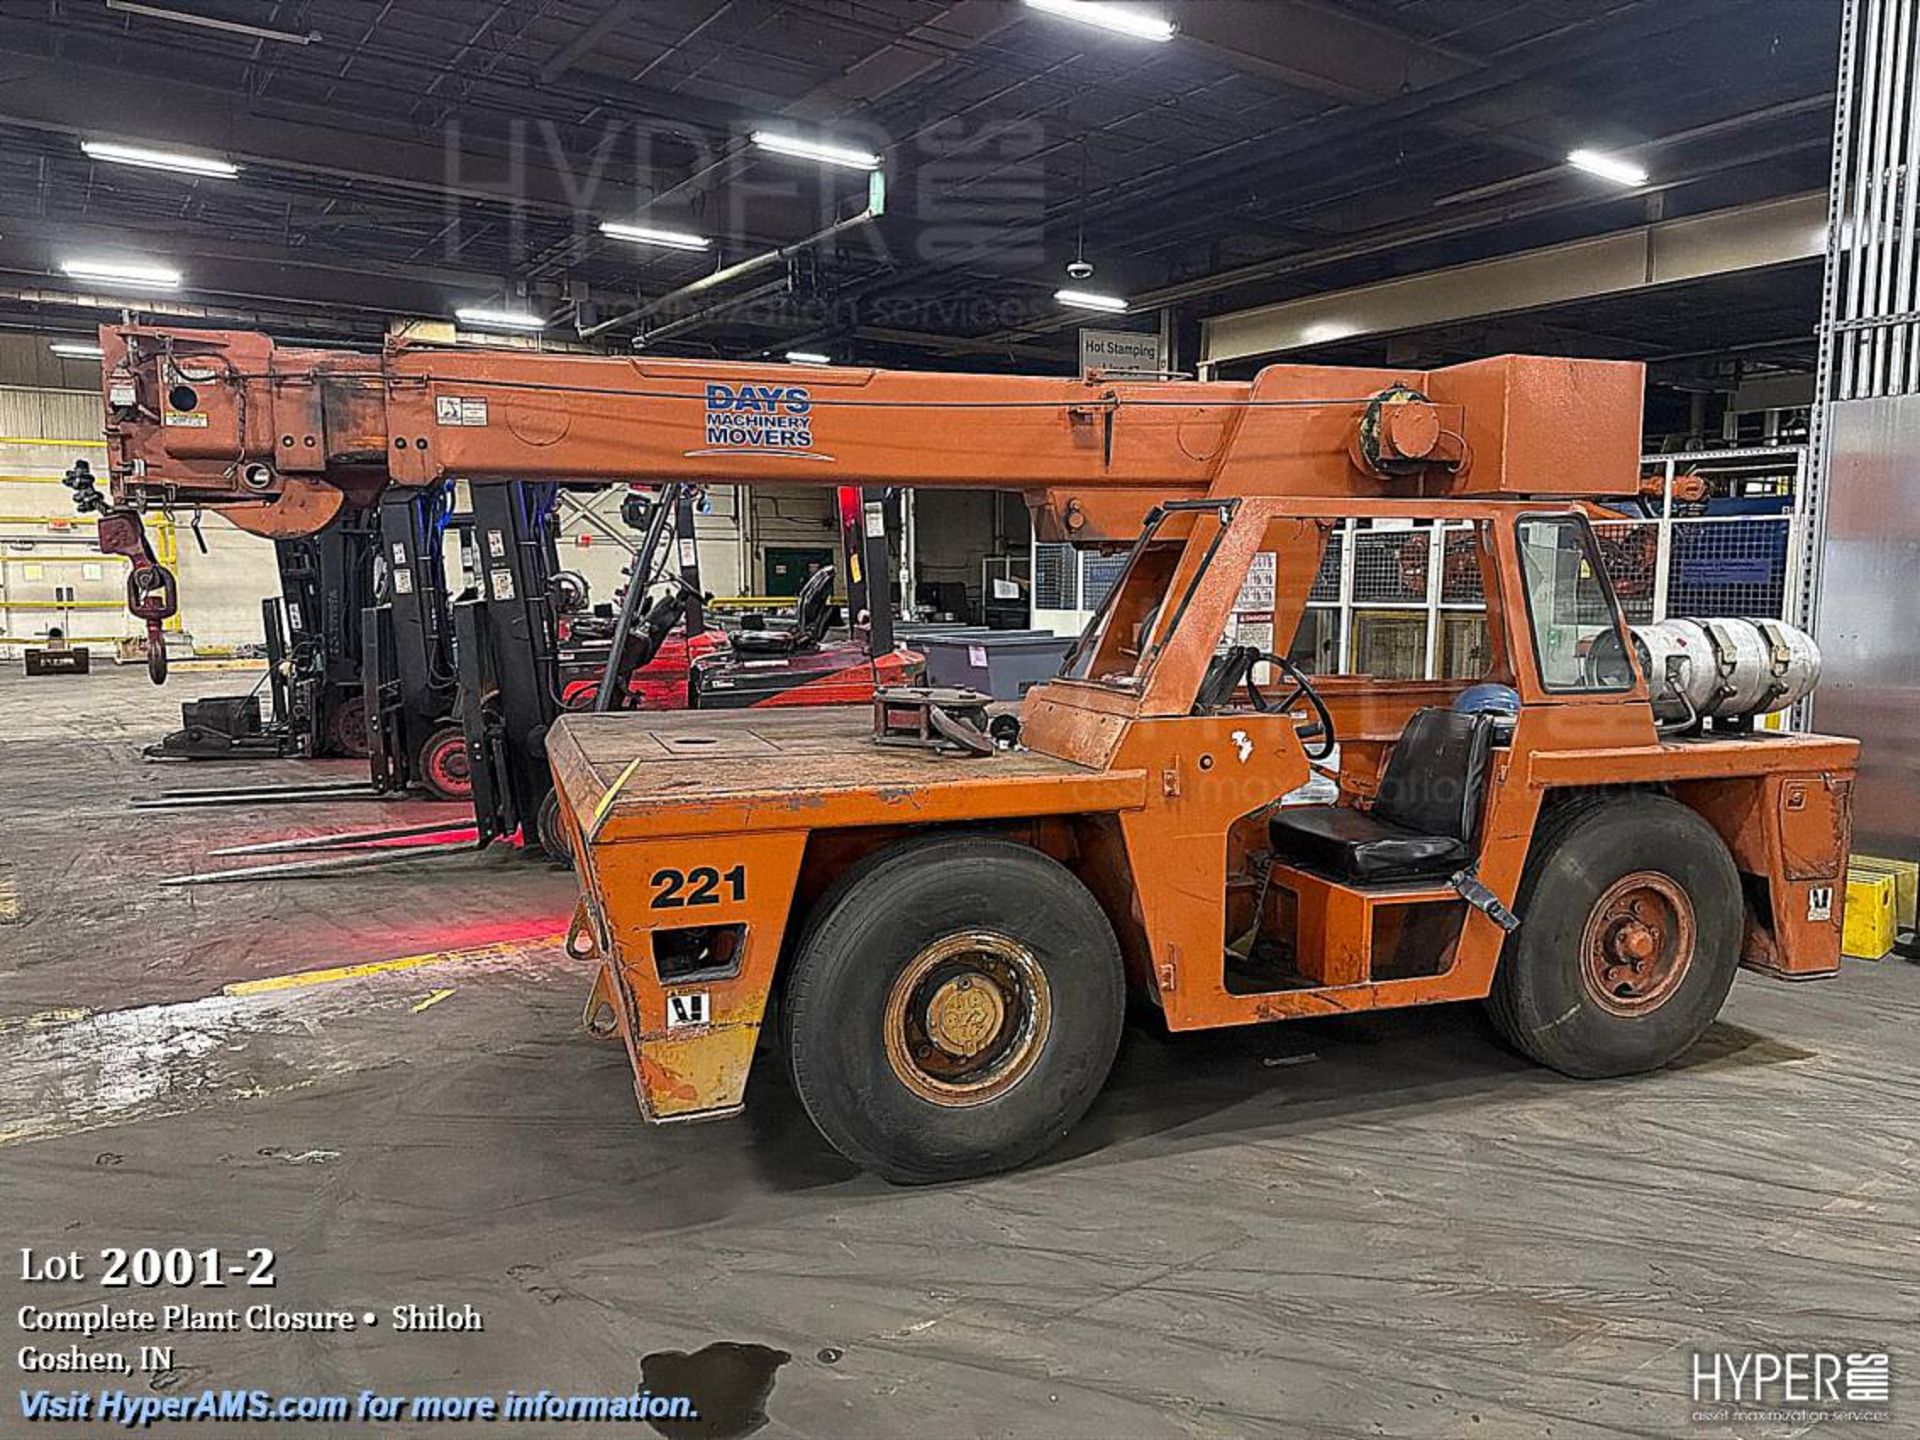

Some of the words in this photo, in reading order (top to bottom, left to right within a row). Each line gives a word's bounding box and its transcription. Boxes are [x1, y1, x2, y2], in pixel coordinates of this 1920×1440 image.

[1086, 341, 1105, 353] Hot
[1107, 342, 1155, 360] Stamping
[706, 383, 811, 414] DAYS
[706, 413, 812, 429] MACHINERY
[706, 429, 813, 446] MOVERS
[651, 865, 745, 909] 221
